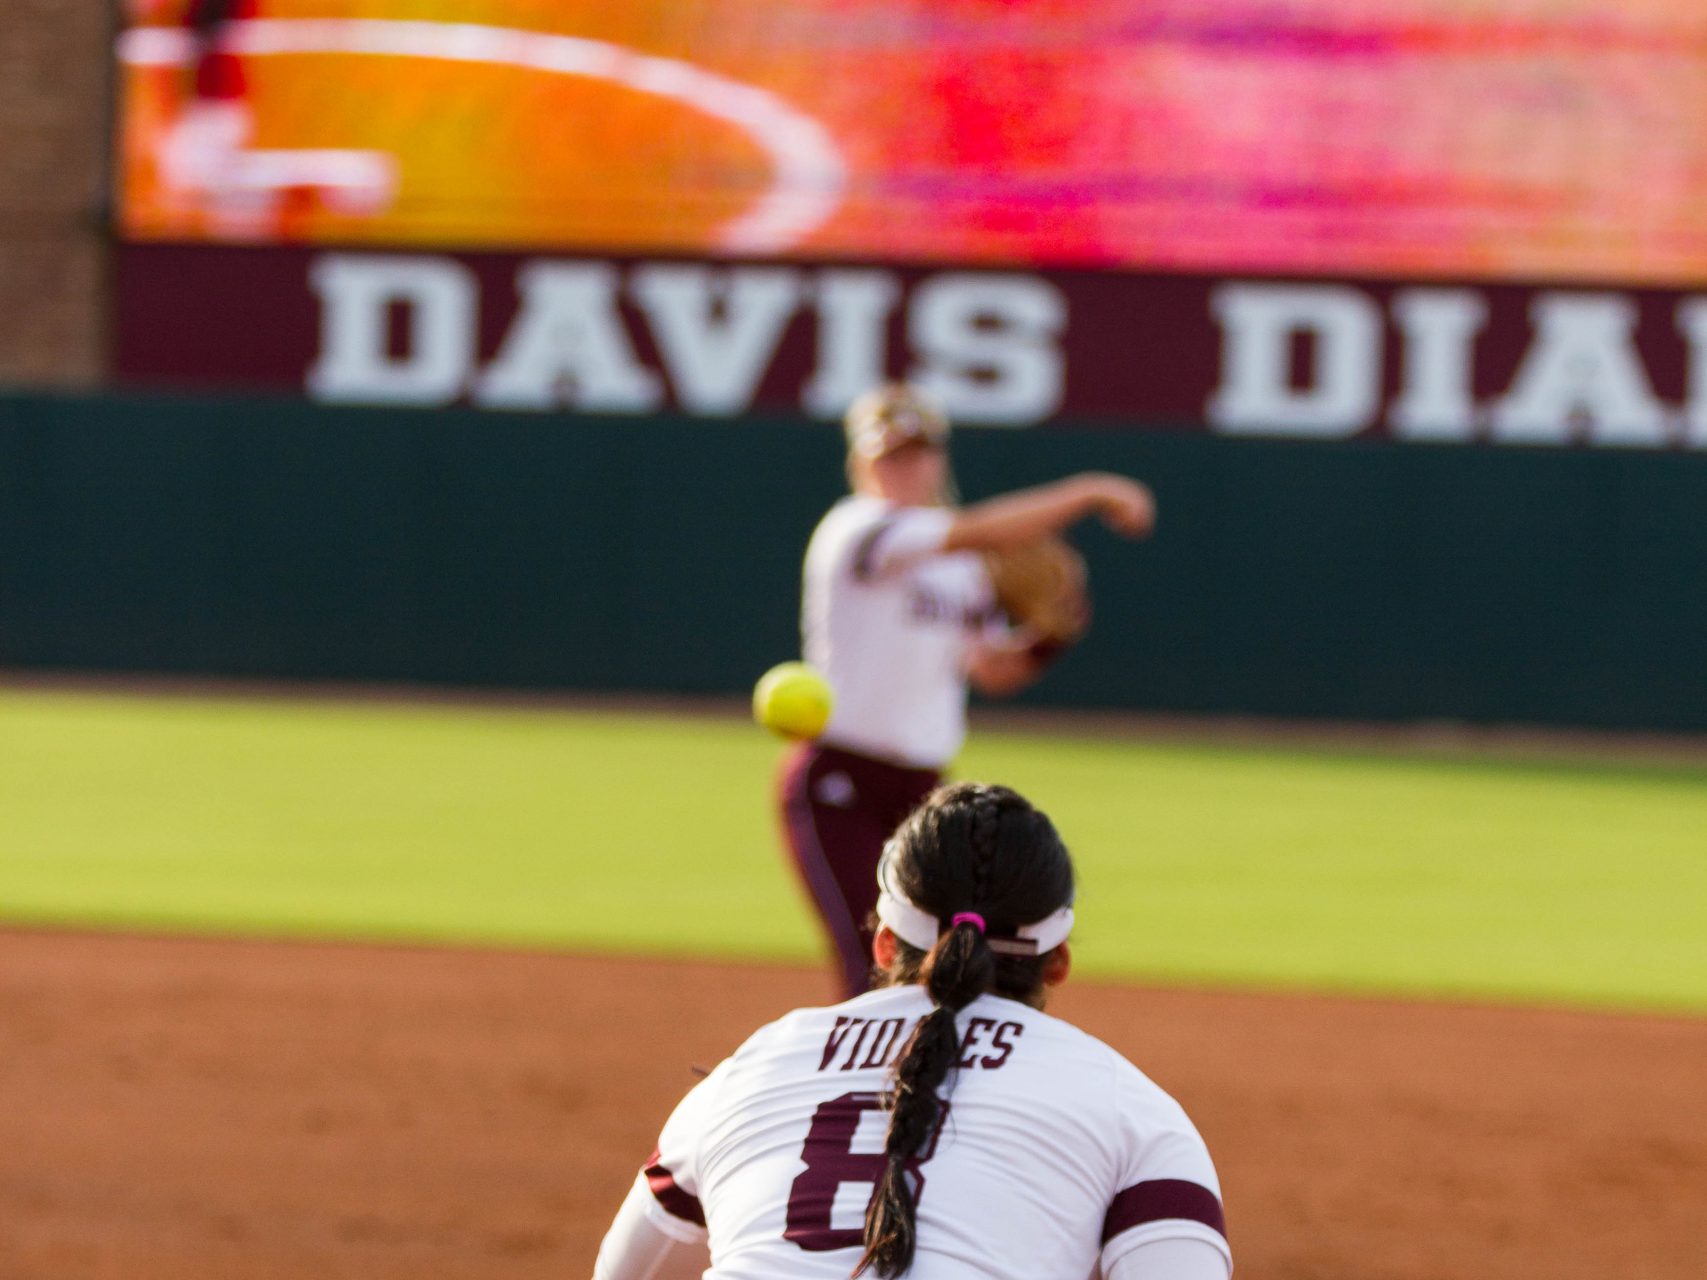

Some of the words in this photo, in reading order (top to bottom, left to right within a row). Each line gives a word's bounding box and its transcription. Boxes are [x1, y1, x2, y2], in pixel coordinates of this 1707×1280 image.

[306, 254, 1067, 427] DAVIS
[1206, 281, 1707, 448] DIA
[818, 1016, 1024, 1071] VIDES
[783, 1091, 951, 1251] 8
